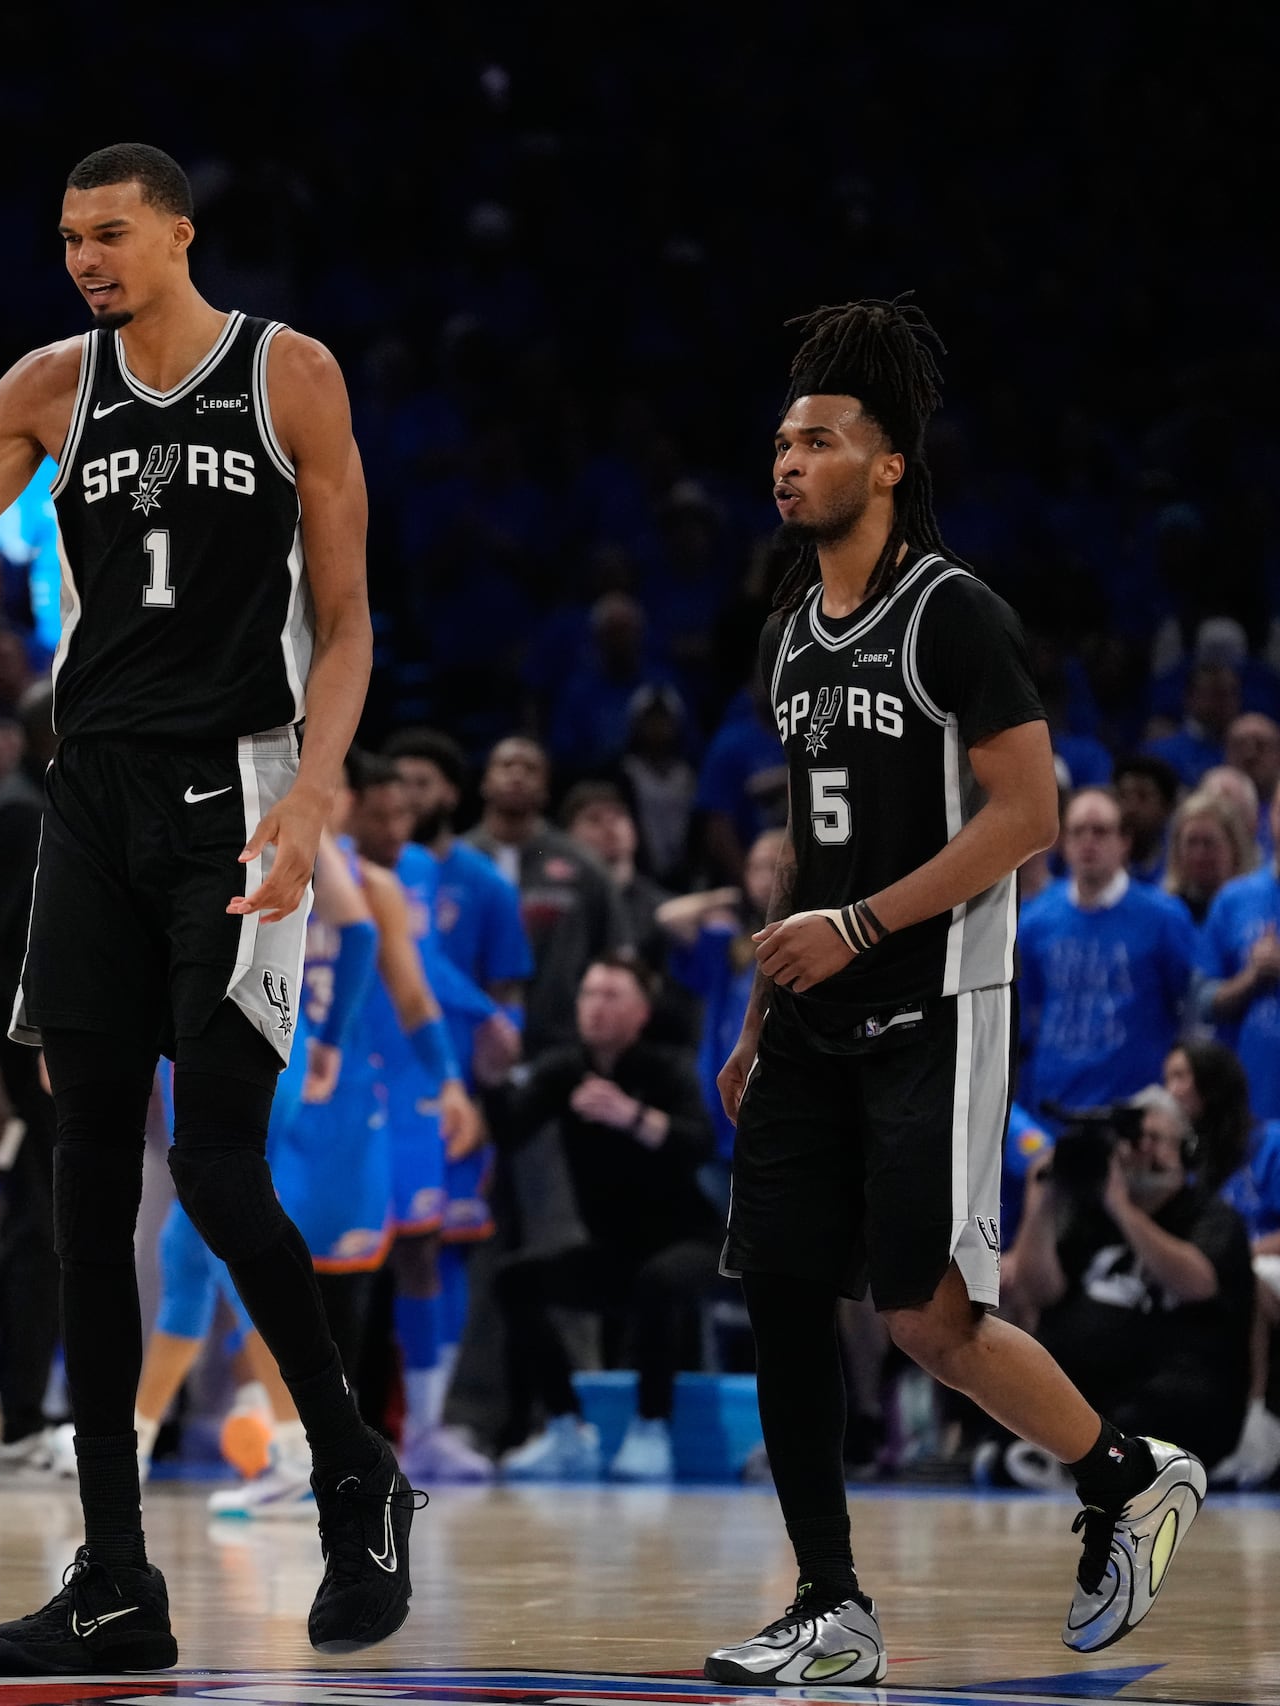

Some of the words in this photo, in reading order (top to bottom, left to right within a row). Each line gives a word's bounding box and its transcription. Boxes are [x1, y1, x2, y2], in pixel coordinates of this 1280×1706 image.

[202, 399, 242, 409] LEDGER
[82, 443, 256, 516] SPURS
[141, 528, 176, 608] 1
[857, 653, 889, 663] LEDGER
[807, 766, 853, 846] 5
